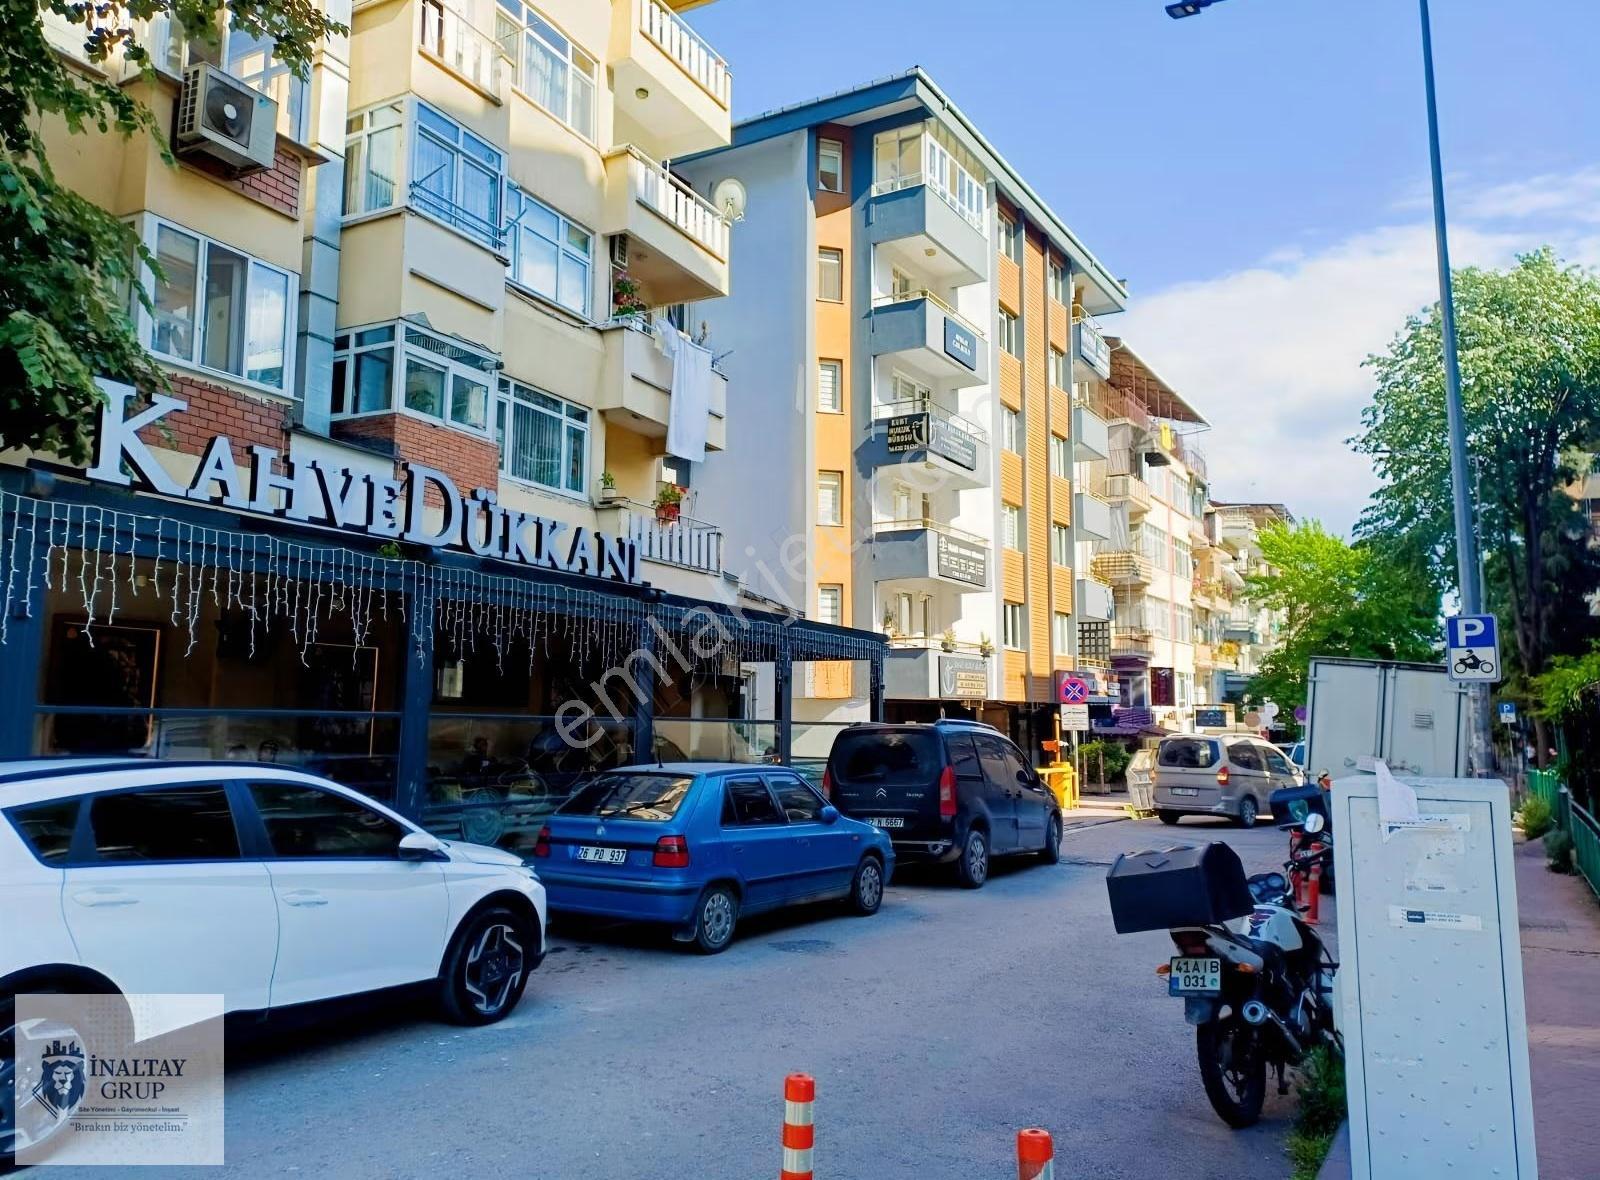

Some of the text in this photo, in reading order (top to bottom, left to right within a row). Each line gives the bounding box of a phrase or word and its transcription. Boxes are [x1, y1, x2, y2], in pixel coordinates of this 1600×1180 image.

[1457, 618, 1485, 646] P
[1503, 704, 1511, 712] P
[610, 850, 625, 861] 937
[1184, 975, 1207, 987] 031
